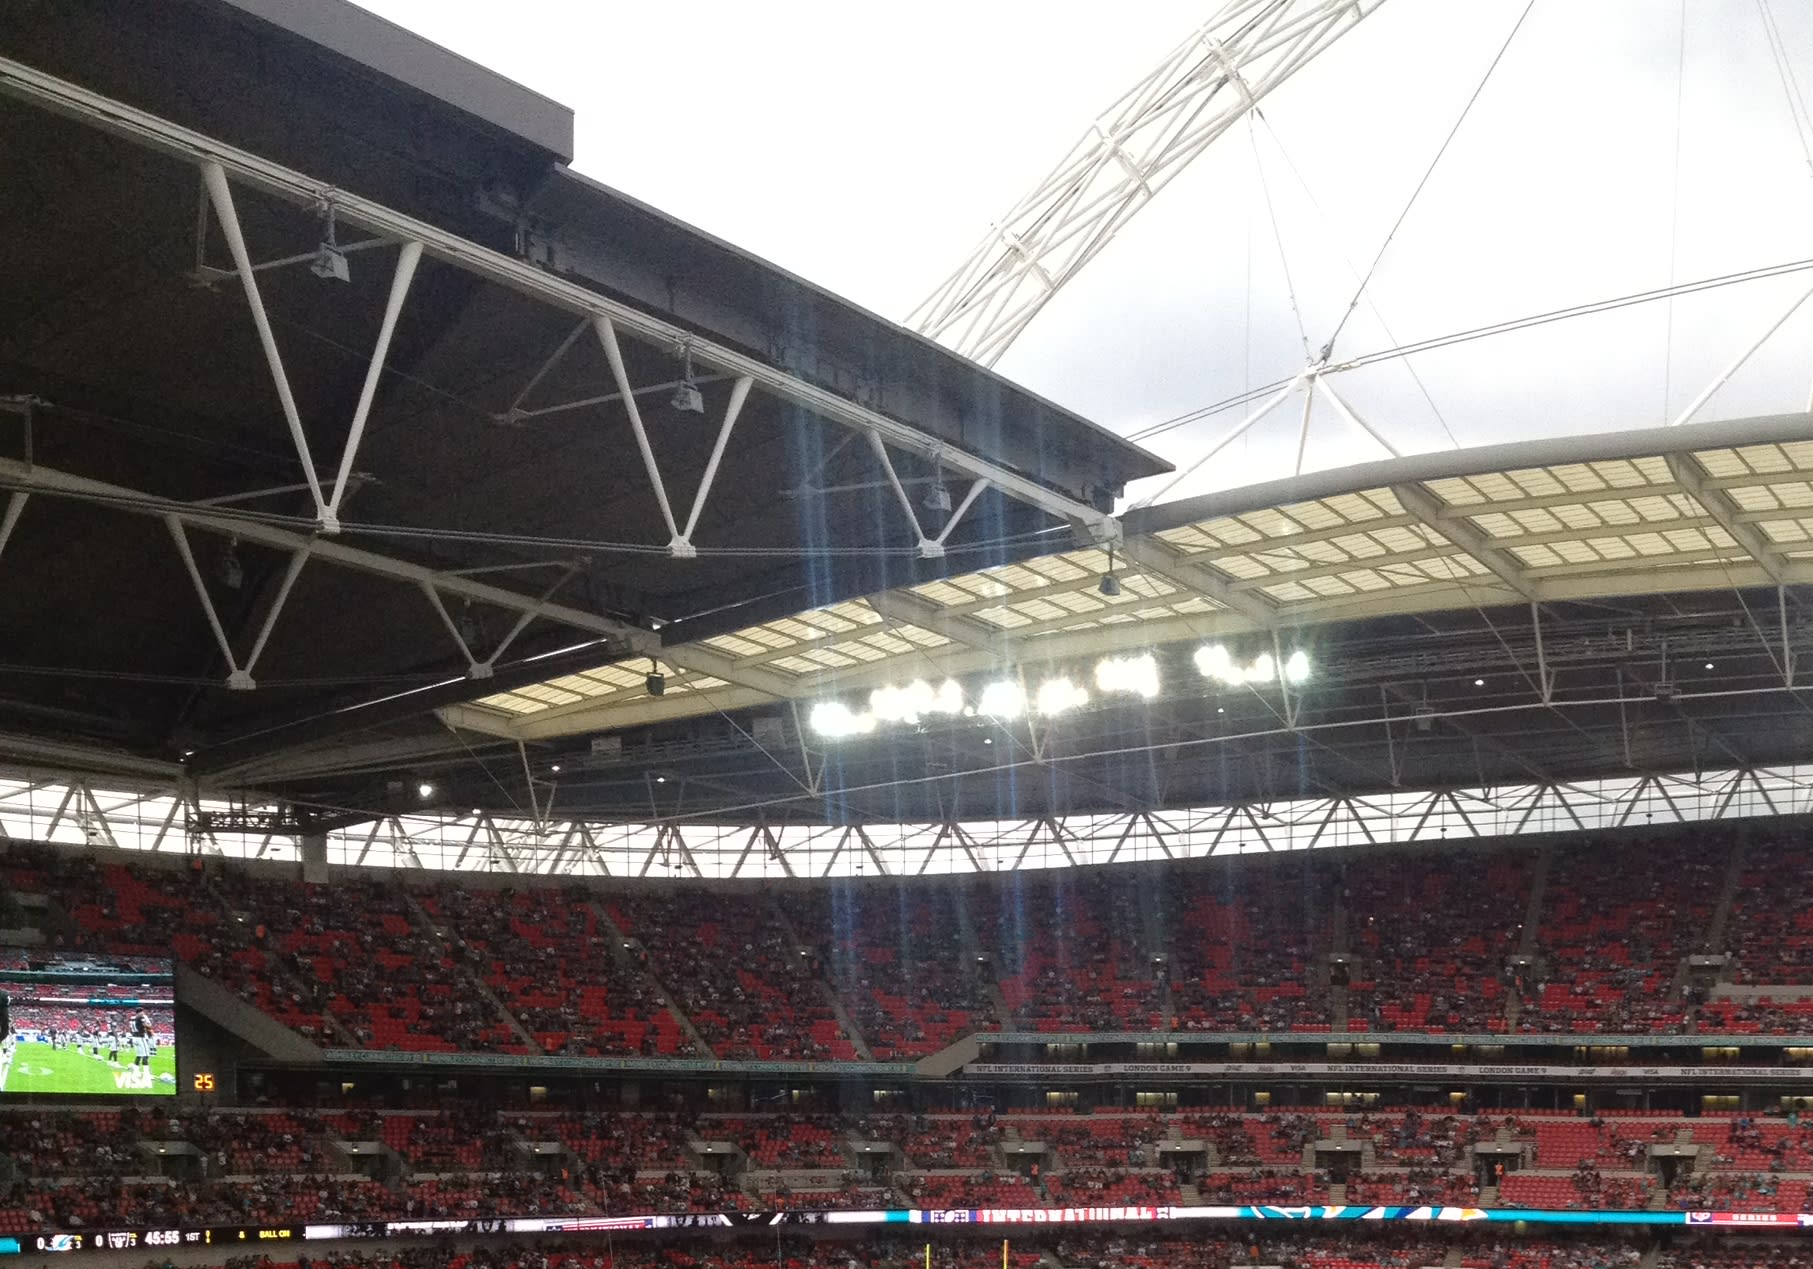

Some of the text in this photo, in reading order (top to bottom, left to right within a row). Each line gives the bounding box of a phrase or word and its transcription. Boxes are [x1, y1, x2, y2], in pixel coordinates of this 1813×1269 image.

[976, 1065, 1093, 1073] NFL INTERNATIONAL SERIES
[1123, 1064, 1159, 1072] LONDON
[1160, 1064, 1184, 1072] GAME
[1327, 1065, 1447, 1074] NFL INTERNATIONAL SERIES
[1479, 1067, 1514, 1075] LONDON
[1515, 1067, 1540, 1075] GAME
[1681, 1067, 1697, 1076] NFL
[1769, 1068, 1800, 1077] SERIES
[114, 1072, 152, 1089] VISA
[194, 1074, 214, 1089] 25
[37, 1237, 44, 1250] 0
[95, 1235, 103, 1247] 0
[145, 1230, 180, 1246] 45:55
[185, 1231, 200, 1242] 1ST
[259, 1230, 274, 1239] BALL
[275, 1230, 290, 1239] ON
